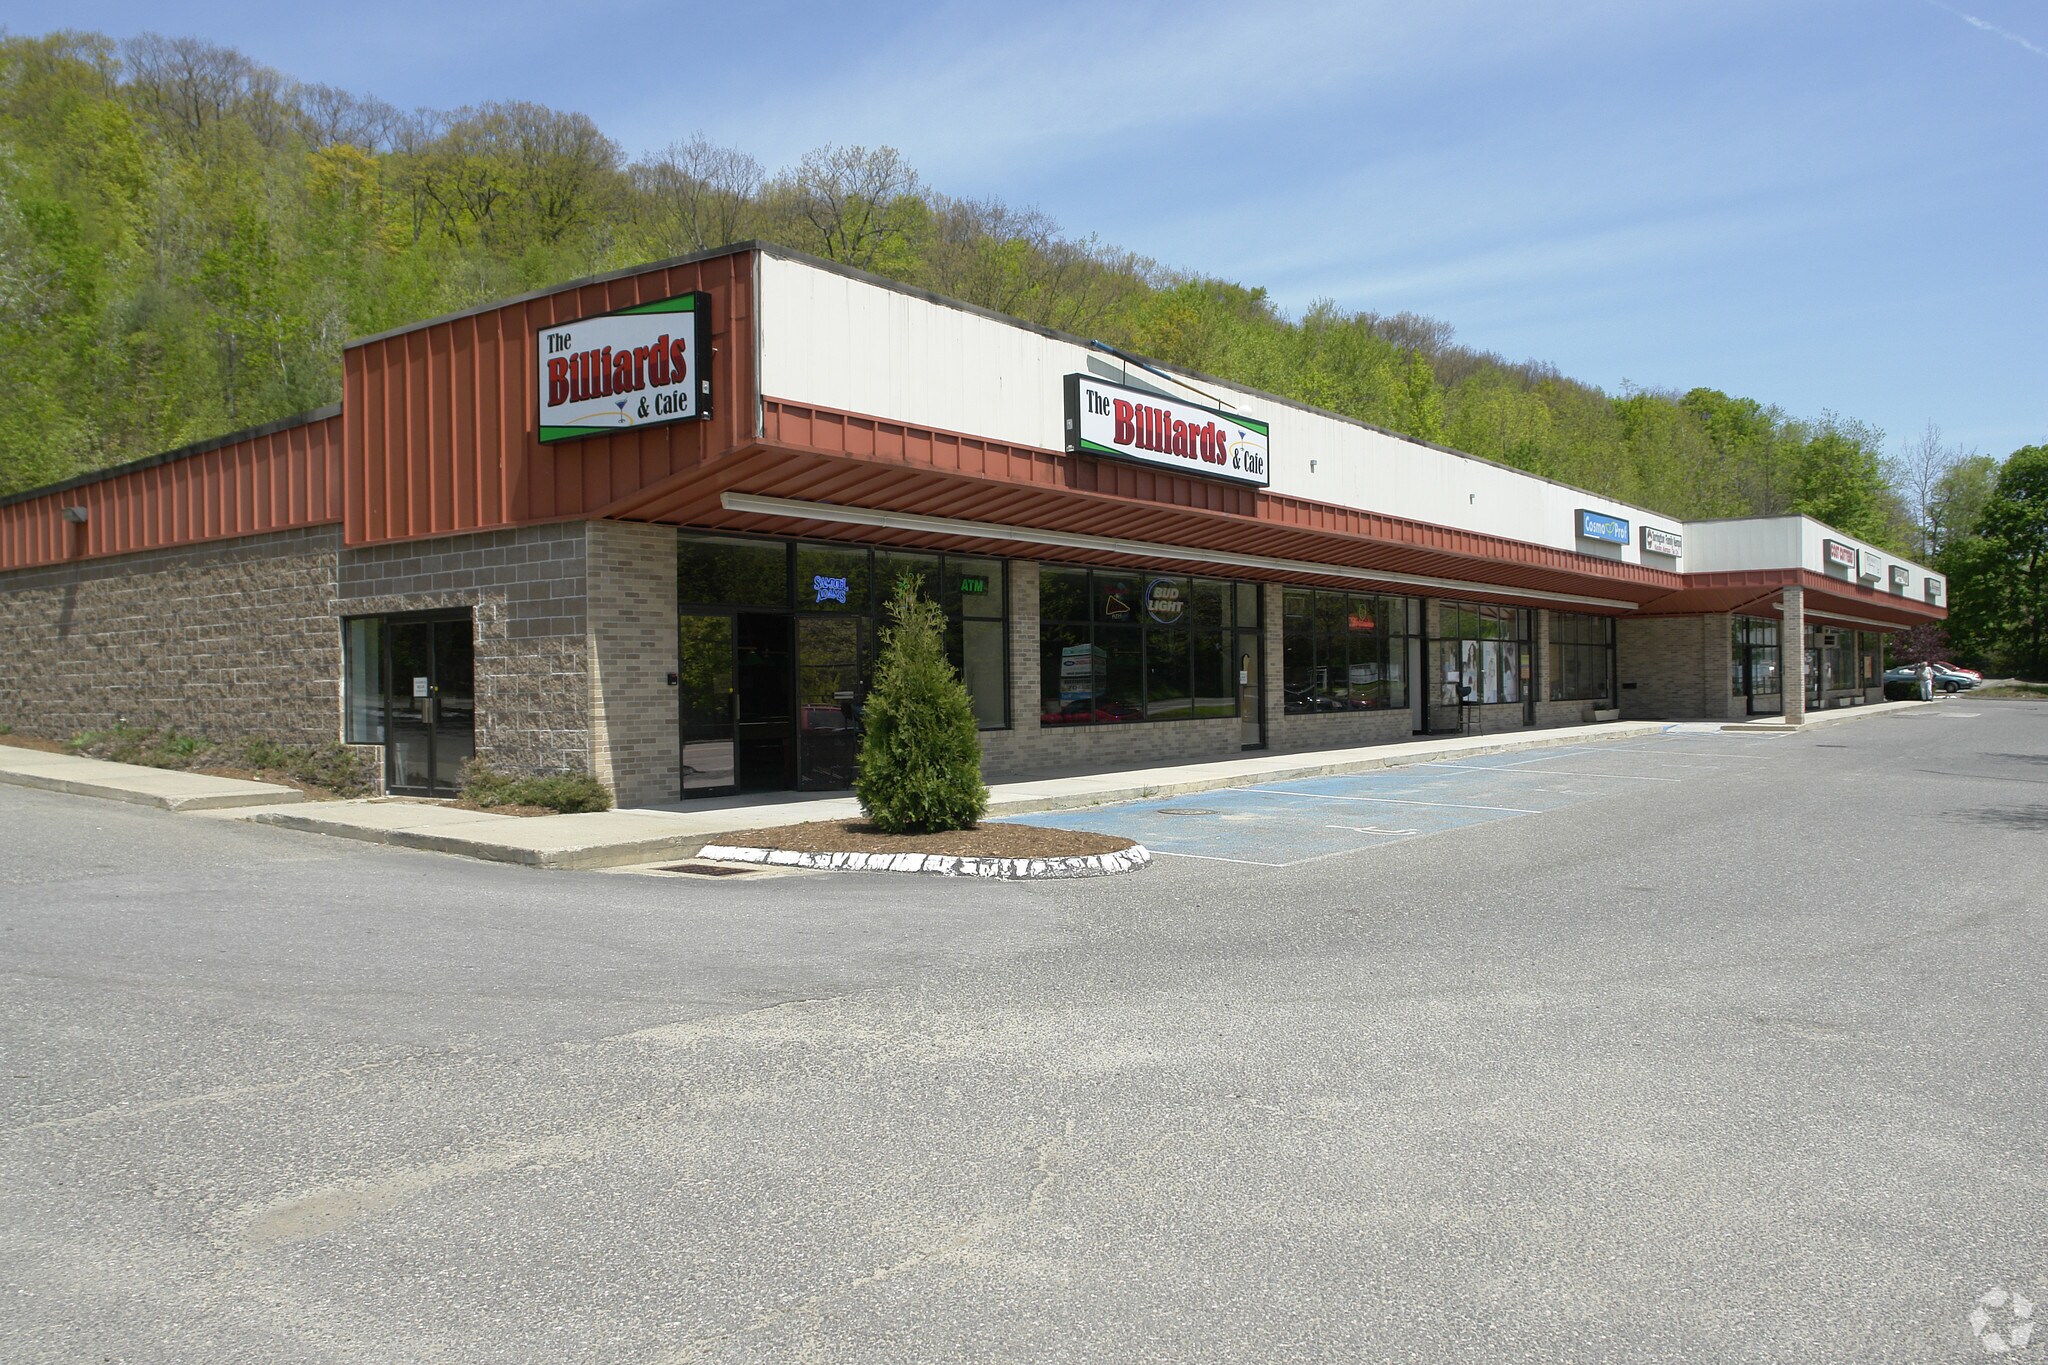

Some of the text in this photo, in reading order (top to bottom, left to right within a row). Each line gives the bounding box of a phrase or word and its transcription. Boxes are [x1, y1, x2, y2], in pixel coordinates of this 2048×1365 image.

[547, 332, 572, 354] The
[547, 334, 687, 408] Billiards
[637, 396, 649, 419] &
[1086, 389, 1110, 416] The
[1113, 398, 1227, 466] Billiards
[1232, 448, 1241, 470] &
[1585, 516, 1628, 539] Cosmo Prof
[813, 575, 848, 591] SAMUEL
[961, 579, 983, 592] ATM
[816, 587, 847, 604] ADAMS
[1153, 587, 1179, 599] BUD
[1147, 600, 1184, 612] LIGHT
